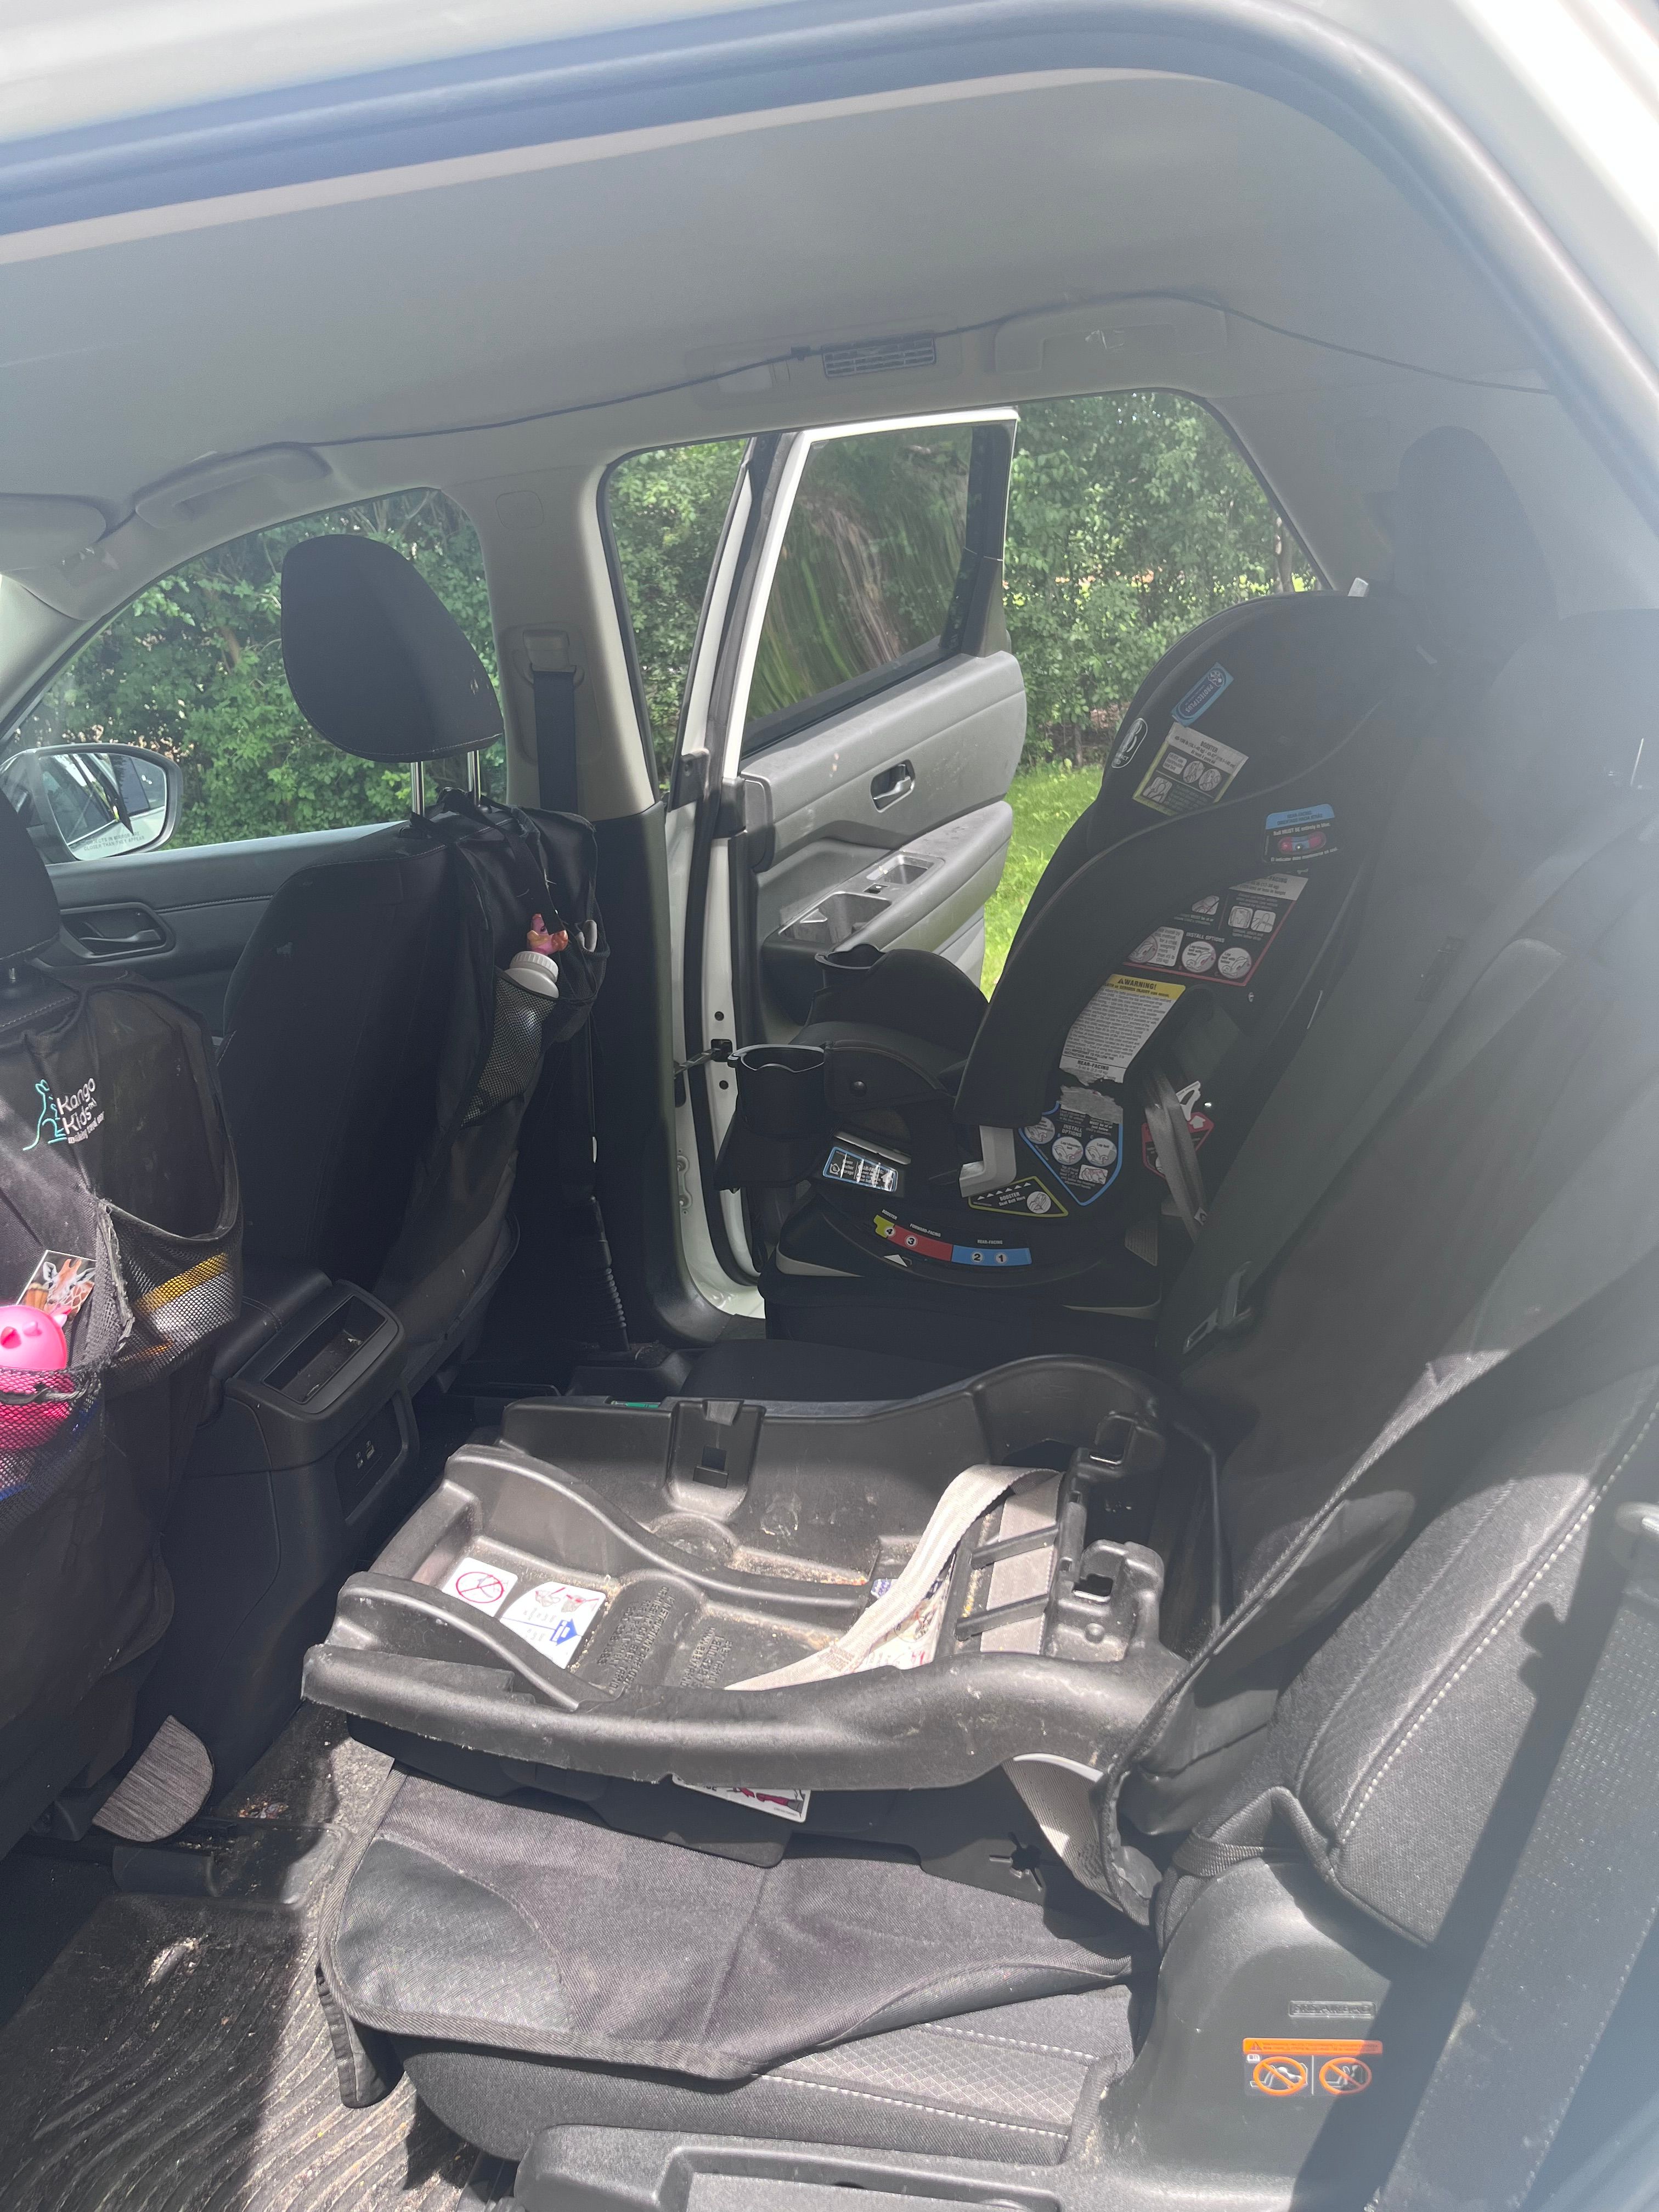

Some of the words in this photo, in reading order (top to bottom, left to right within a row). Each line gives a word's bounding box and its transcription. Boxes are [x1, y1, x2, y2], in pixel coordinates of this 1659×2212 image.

[1125, 979, 1156, 990] WARNING!
[1077, 1060, 1109, 1070] REAR-FACING
[57, 1078, 95, 1114] Kango
[1062, 1129, 1082, 1137] OPTIONS
[999, 1191, 1020, 1200] BOOSTER
[607, 1663, 628, 1690] TREND
